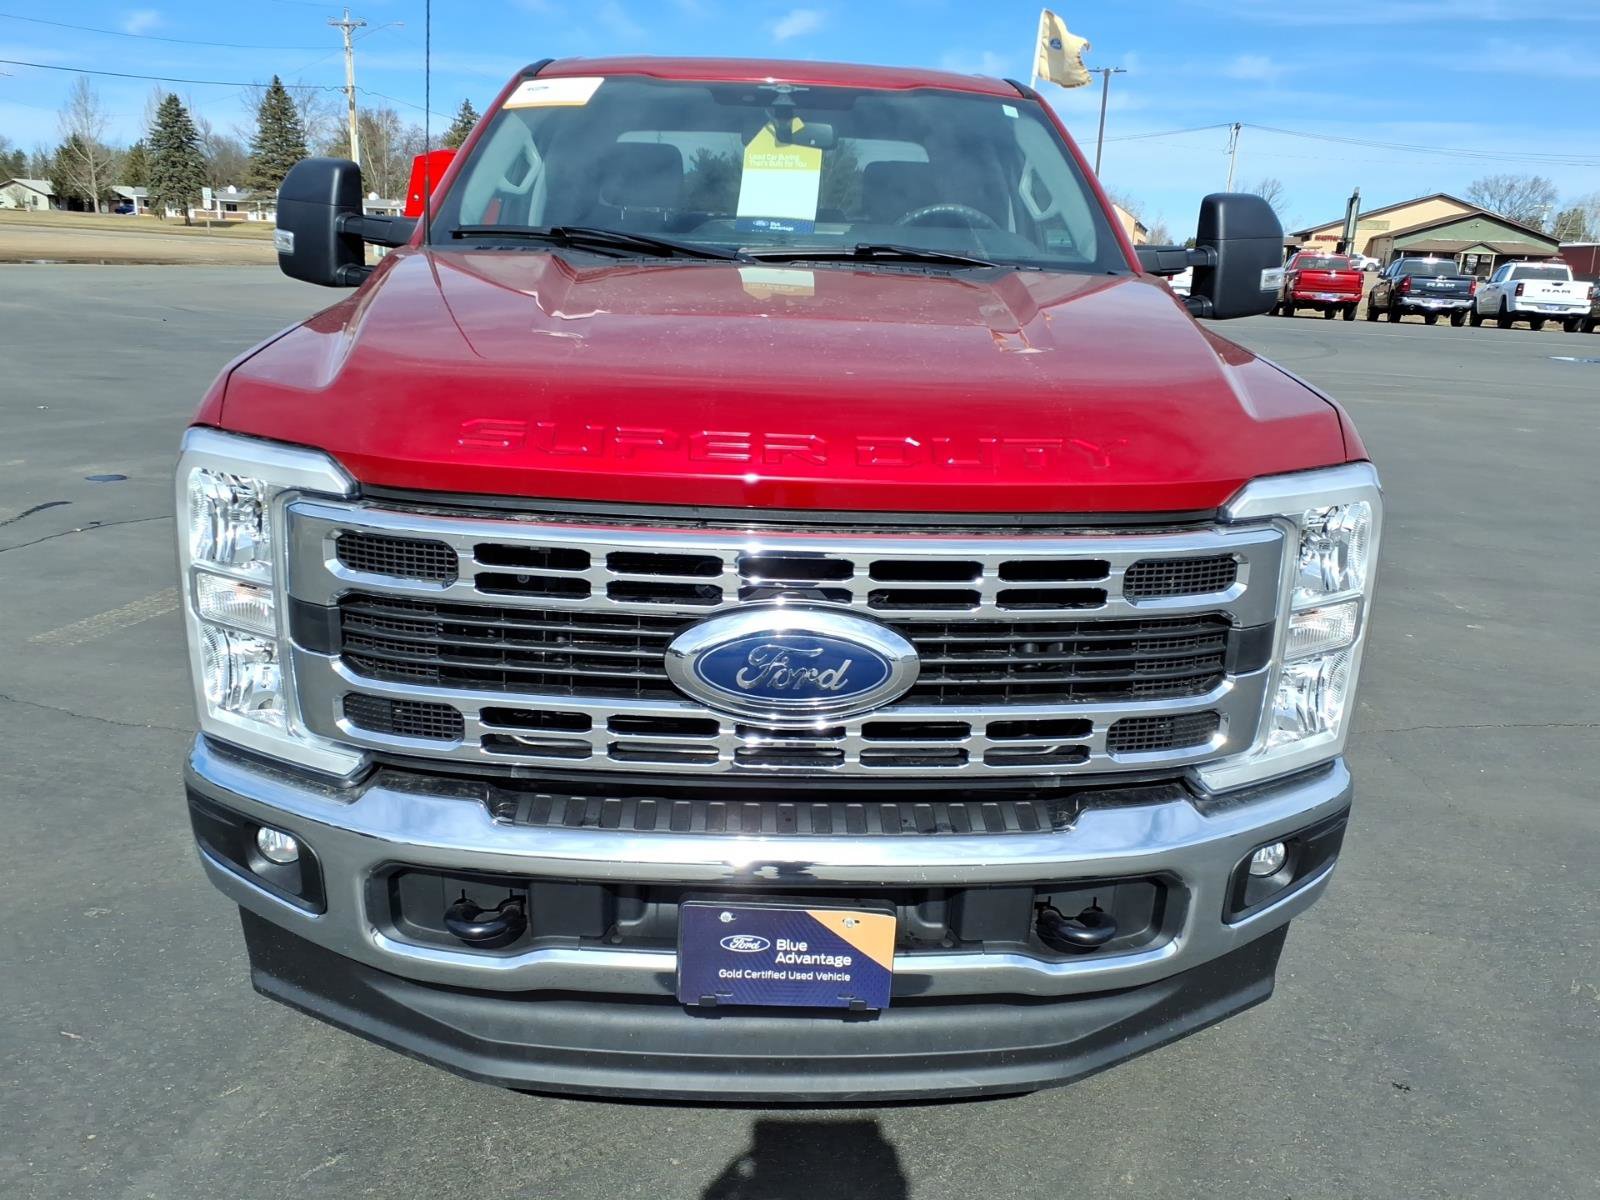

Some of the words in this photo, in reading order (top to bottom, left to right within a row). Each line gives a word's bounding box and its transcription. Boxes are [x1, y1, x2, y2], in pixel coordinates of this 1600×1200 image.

[455, 418, 828, 466] SUPER
[855, 435, 1128, 470] DUTY
[736, 644, 852, 691] Ford
[729, 935, 762, 950] Ford
[776, 938, 808, 952] Blue
[775, 952, 852, 968] Advantage
[718, 968, 743, 979] Gold
[744, 969, 786, 980] Certified
[788, 970, 814, 981] Used
[815, 971, 851, 982] Vehicle
